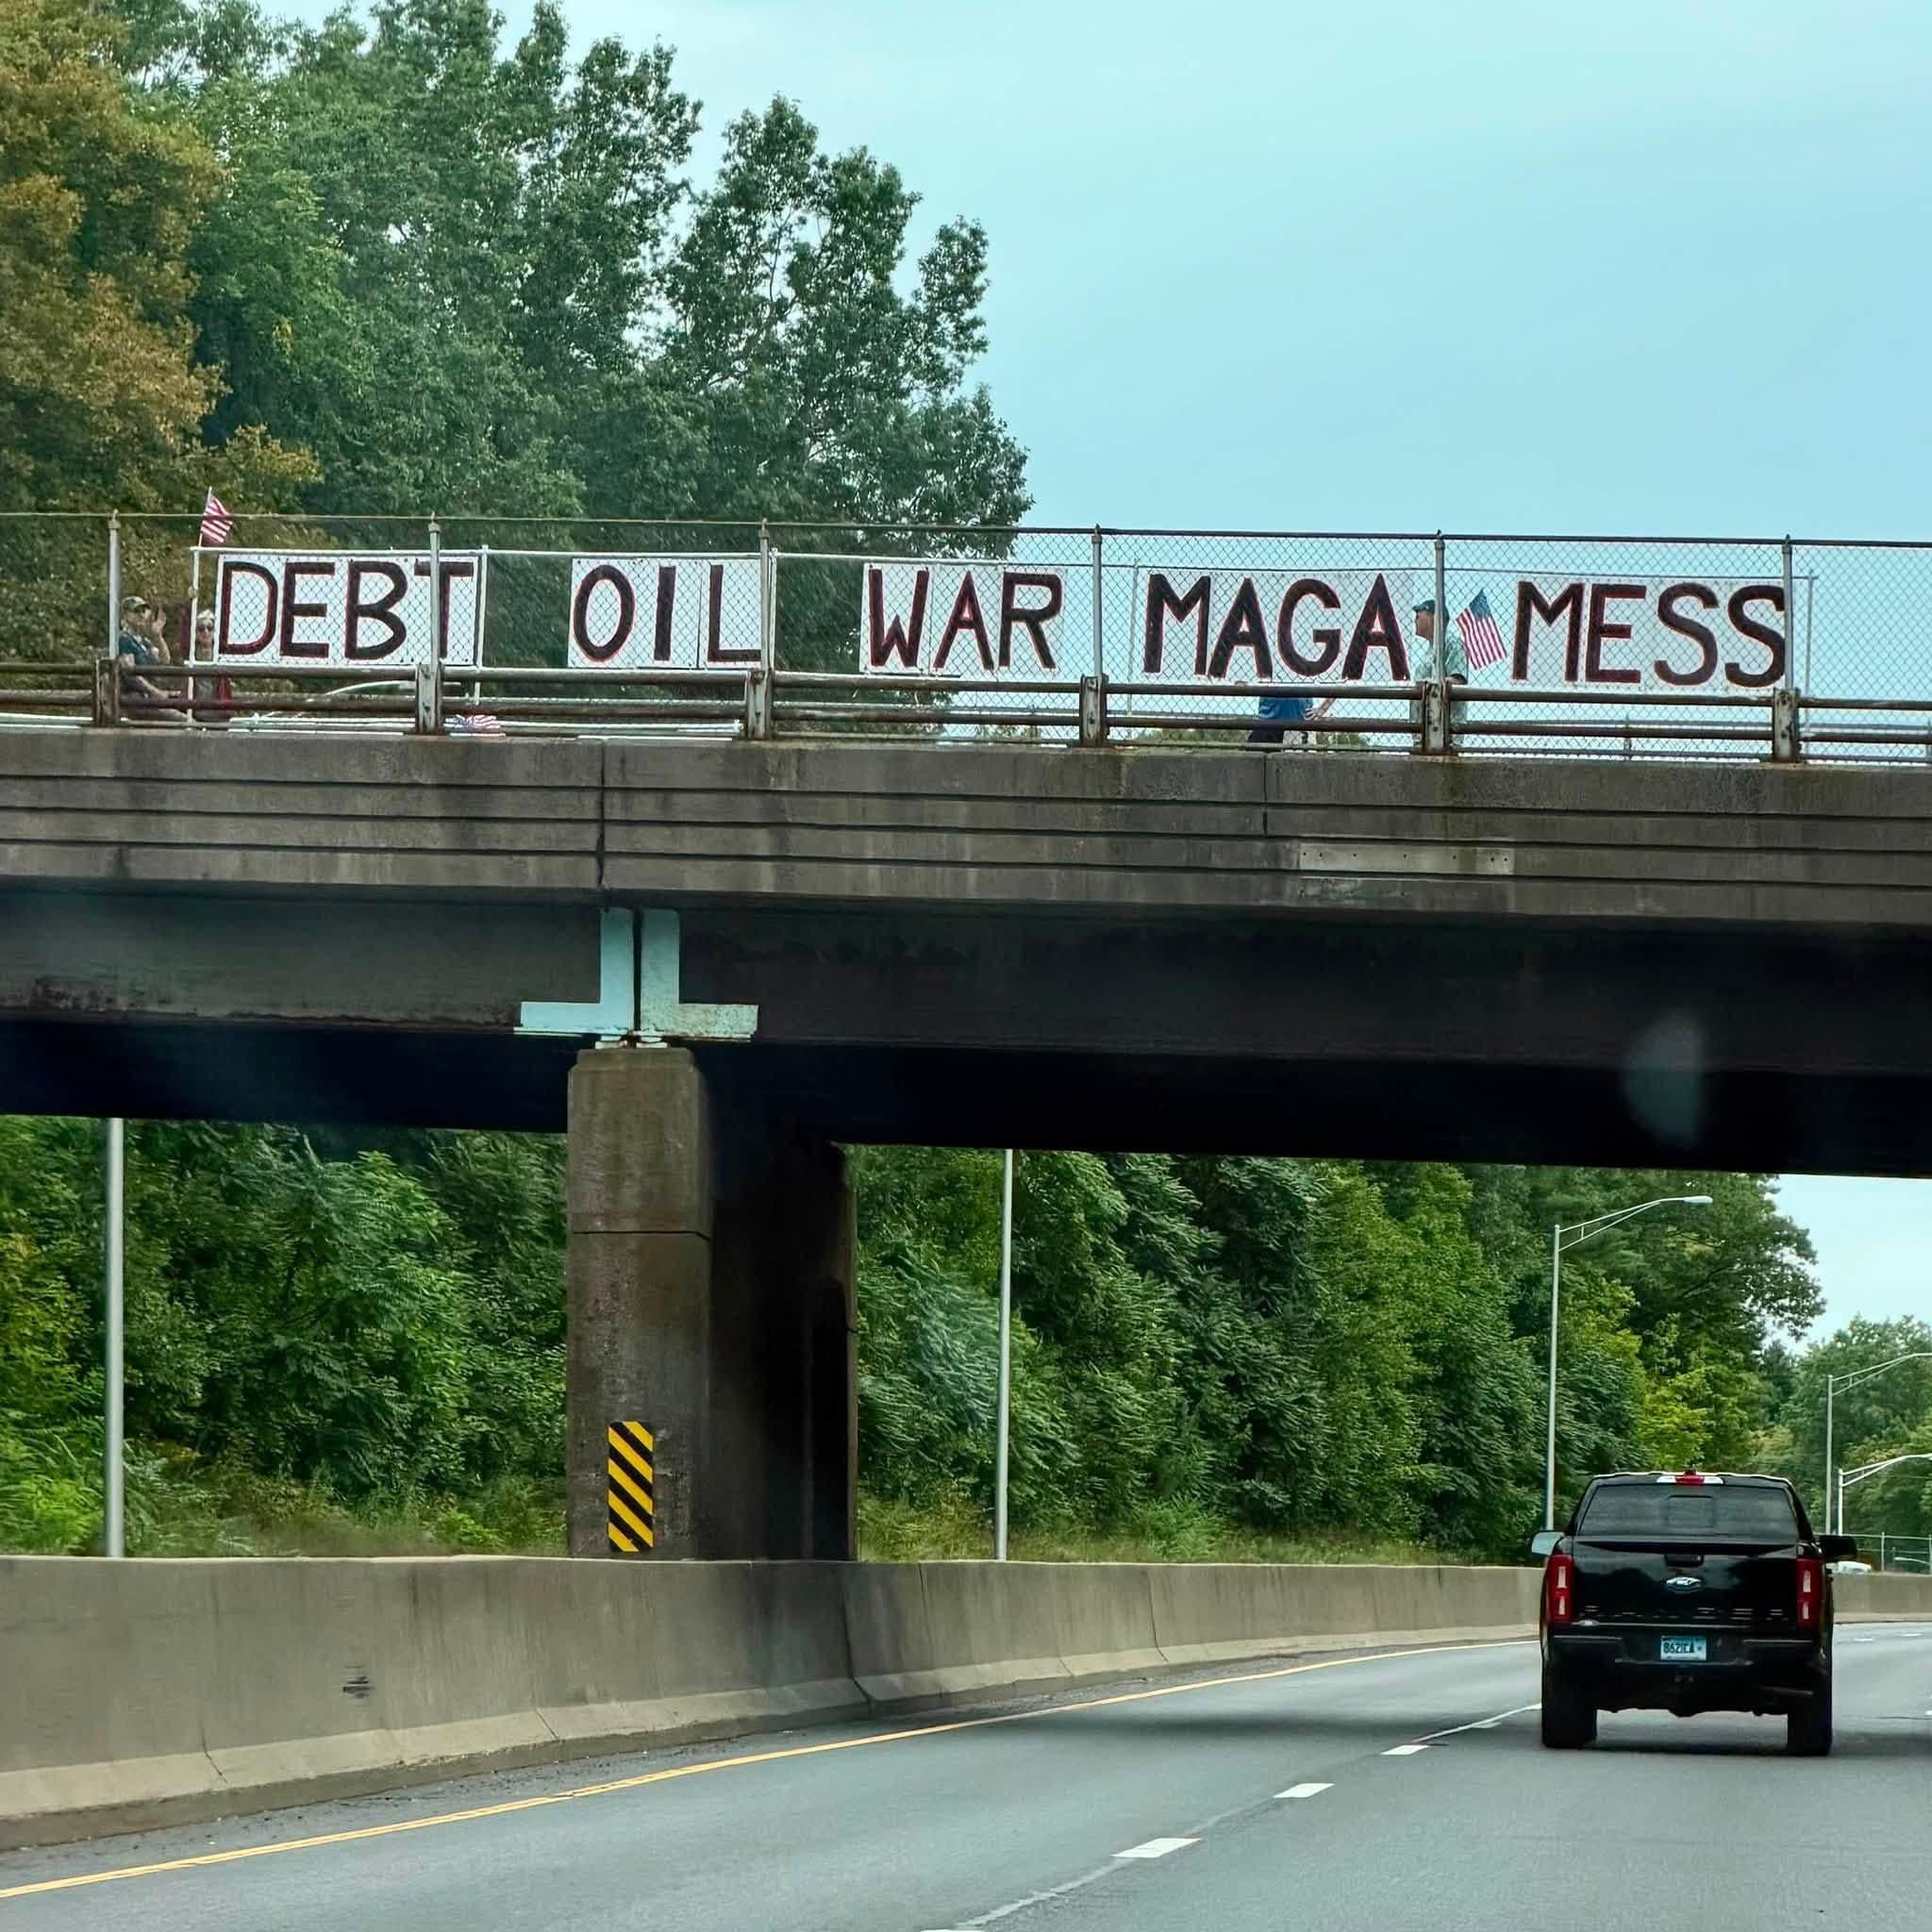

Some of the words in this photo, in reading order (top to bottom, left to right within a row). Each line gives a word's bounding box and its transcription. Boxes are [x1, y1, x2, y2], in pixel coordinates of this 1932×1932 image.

[218, 559, 475, 660] DEBT
[572, 563, 762, 662] OIL
[868, 568, 1063, 671] WAR
[1142, 573, 1411, 681] MAGA
[1511, 580, 1786, 688] MESS
